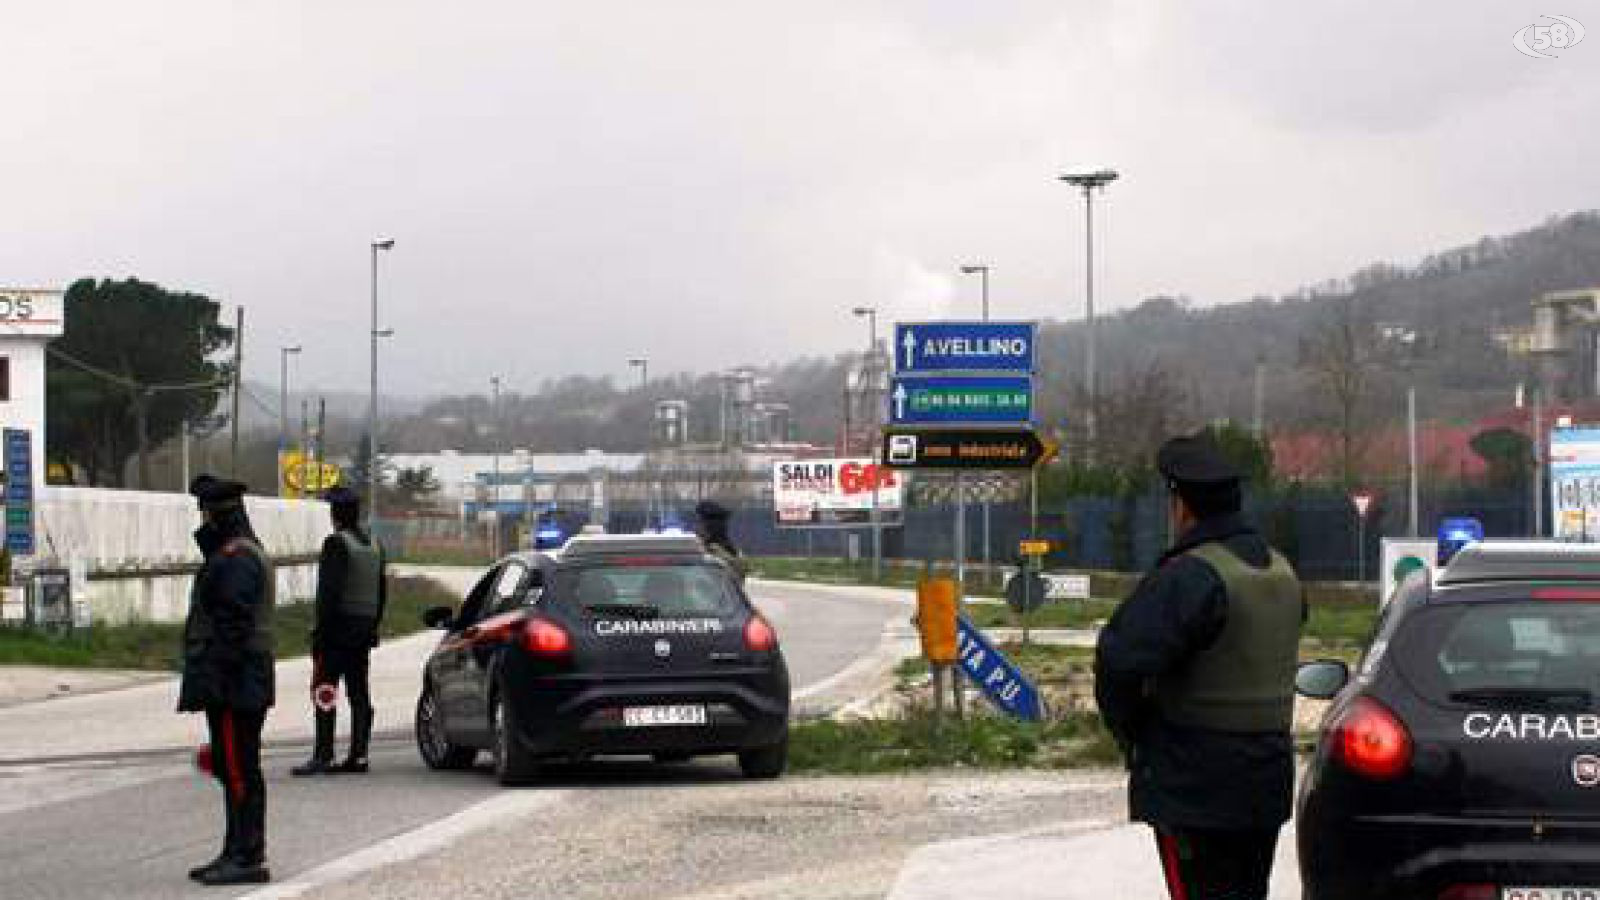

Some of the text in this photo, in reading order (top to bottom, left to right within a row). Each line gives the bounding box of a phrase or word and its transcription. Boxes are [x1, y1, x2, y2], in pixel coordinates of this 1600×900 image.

[923, 337, 1027, 357] AVELLINO
[781, 463, 833, 482] SALDI
[596, 617, 723, 636] CARABINIERI
